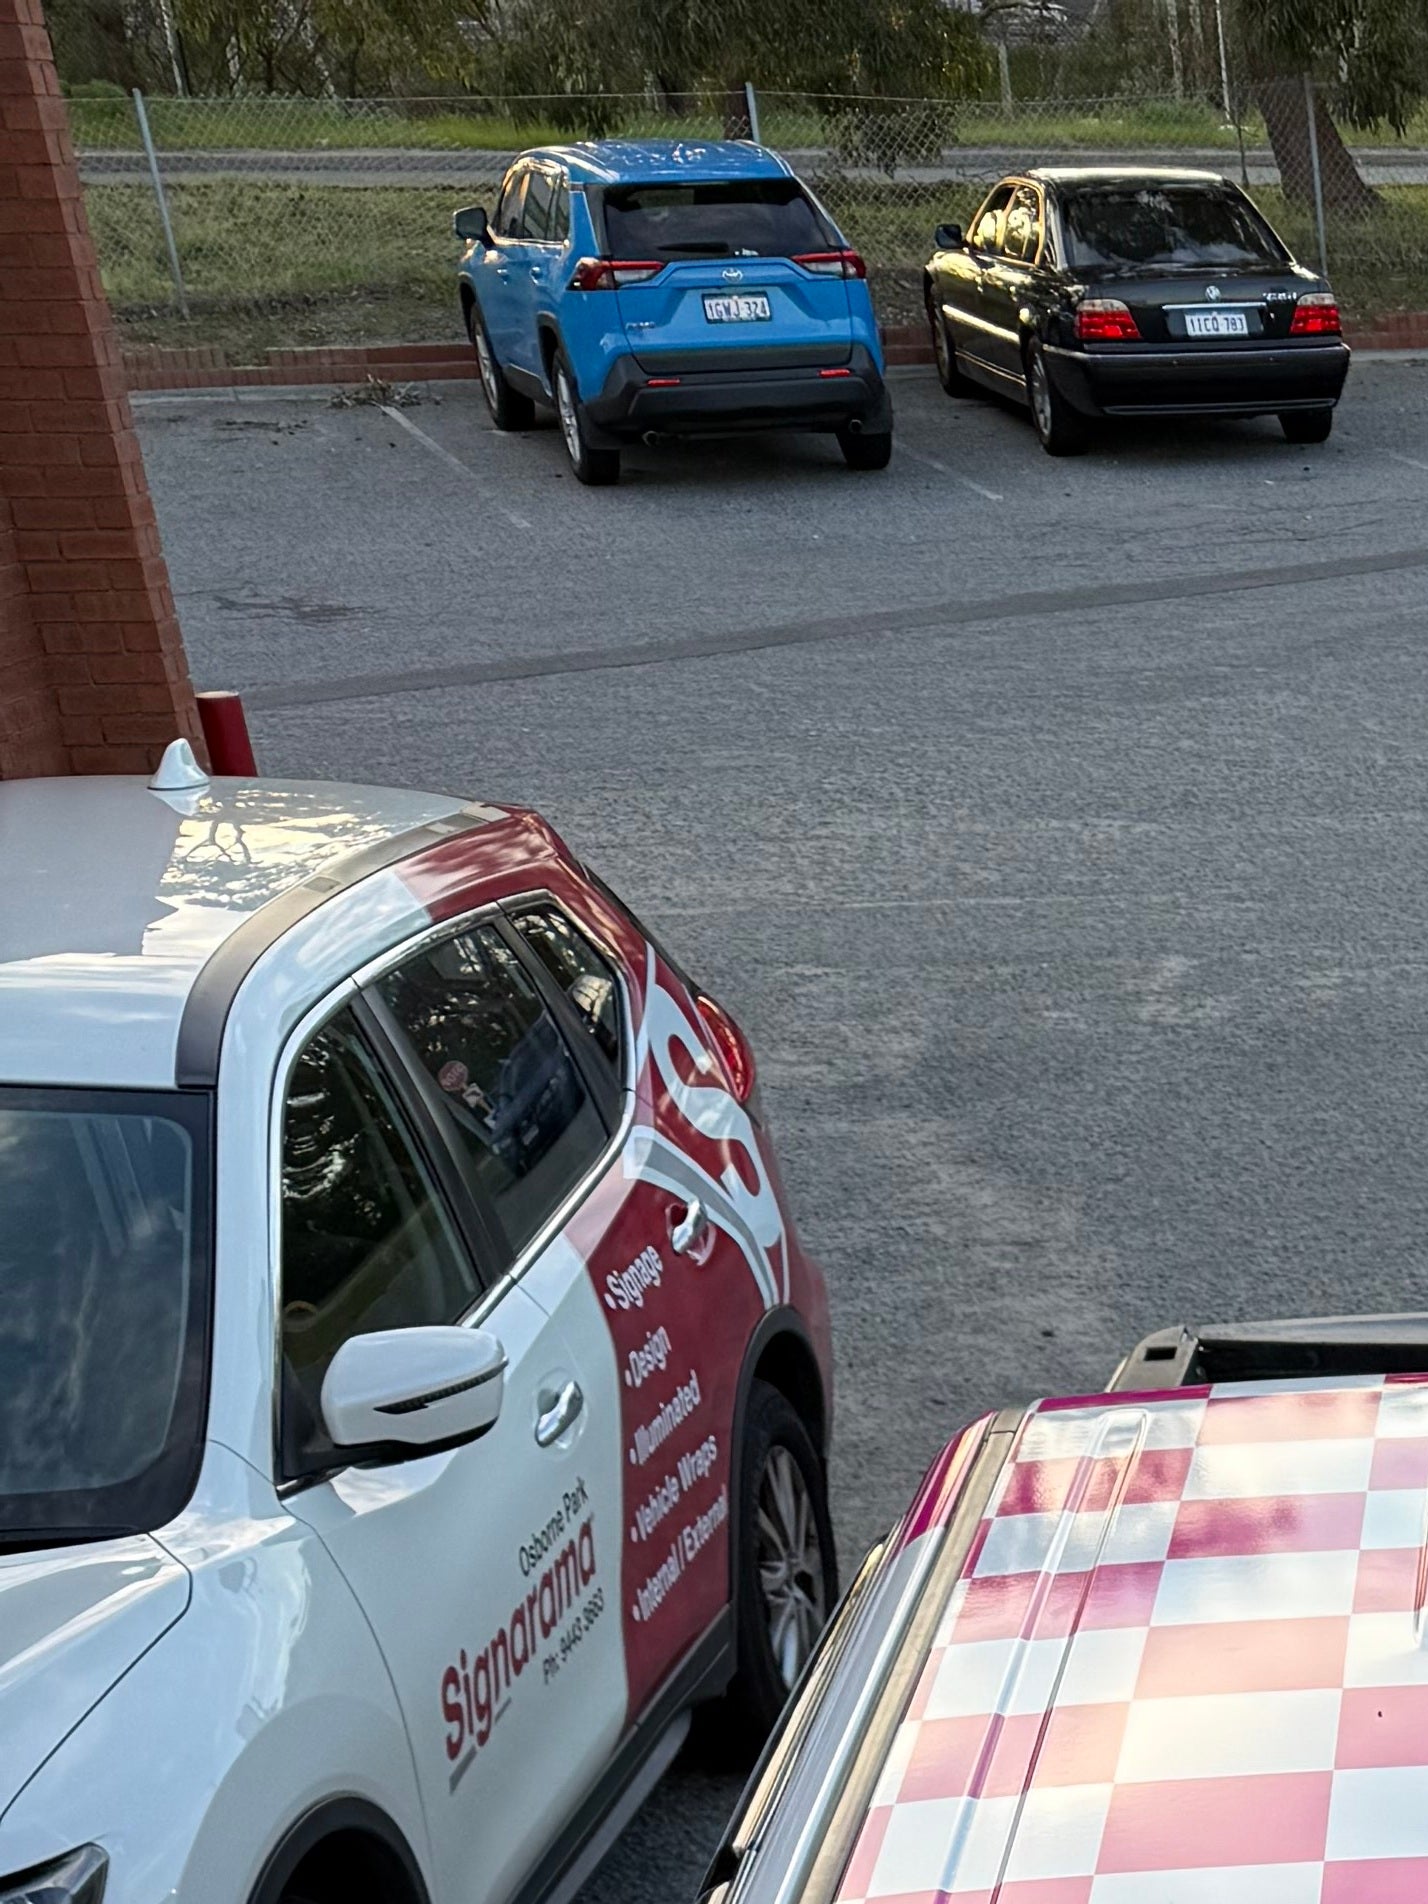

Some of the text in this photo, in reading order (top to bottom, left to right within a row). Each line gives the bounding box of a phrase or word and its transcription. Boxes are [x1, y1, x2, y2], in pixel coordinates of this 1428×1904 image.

[606, 1245, 664, 1310] Signage
[628, 1326, 672, 1388] Design
[634, 1369, 701, 1466] Illuminated
[519, 1476, 588, 1577] Osborne Park
[636, 1435, 717, 1541] Vehicle Wraps
[636, 1543, 681, 1621] Internal
[441, 1519, 597, 1761] Signarama
